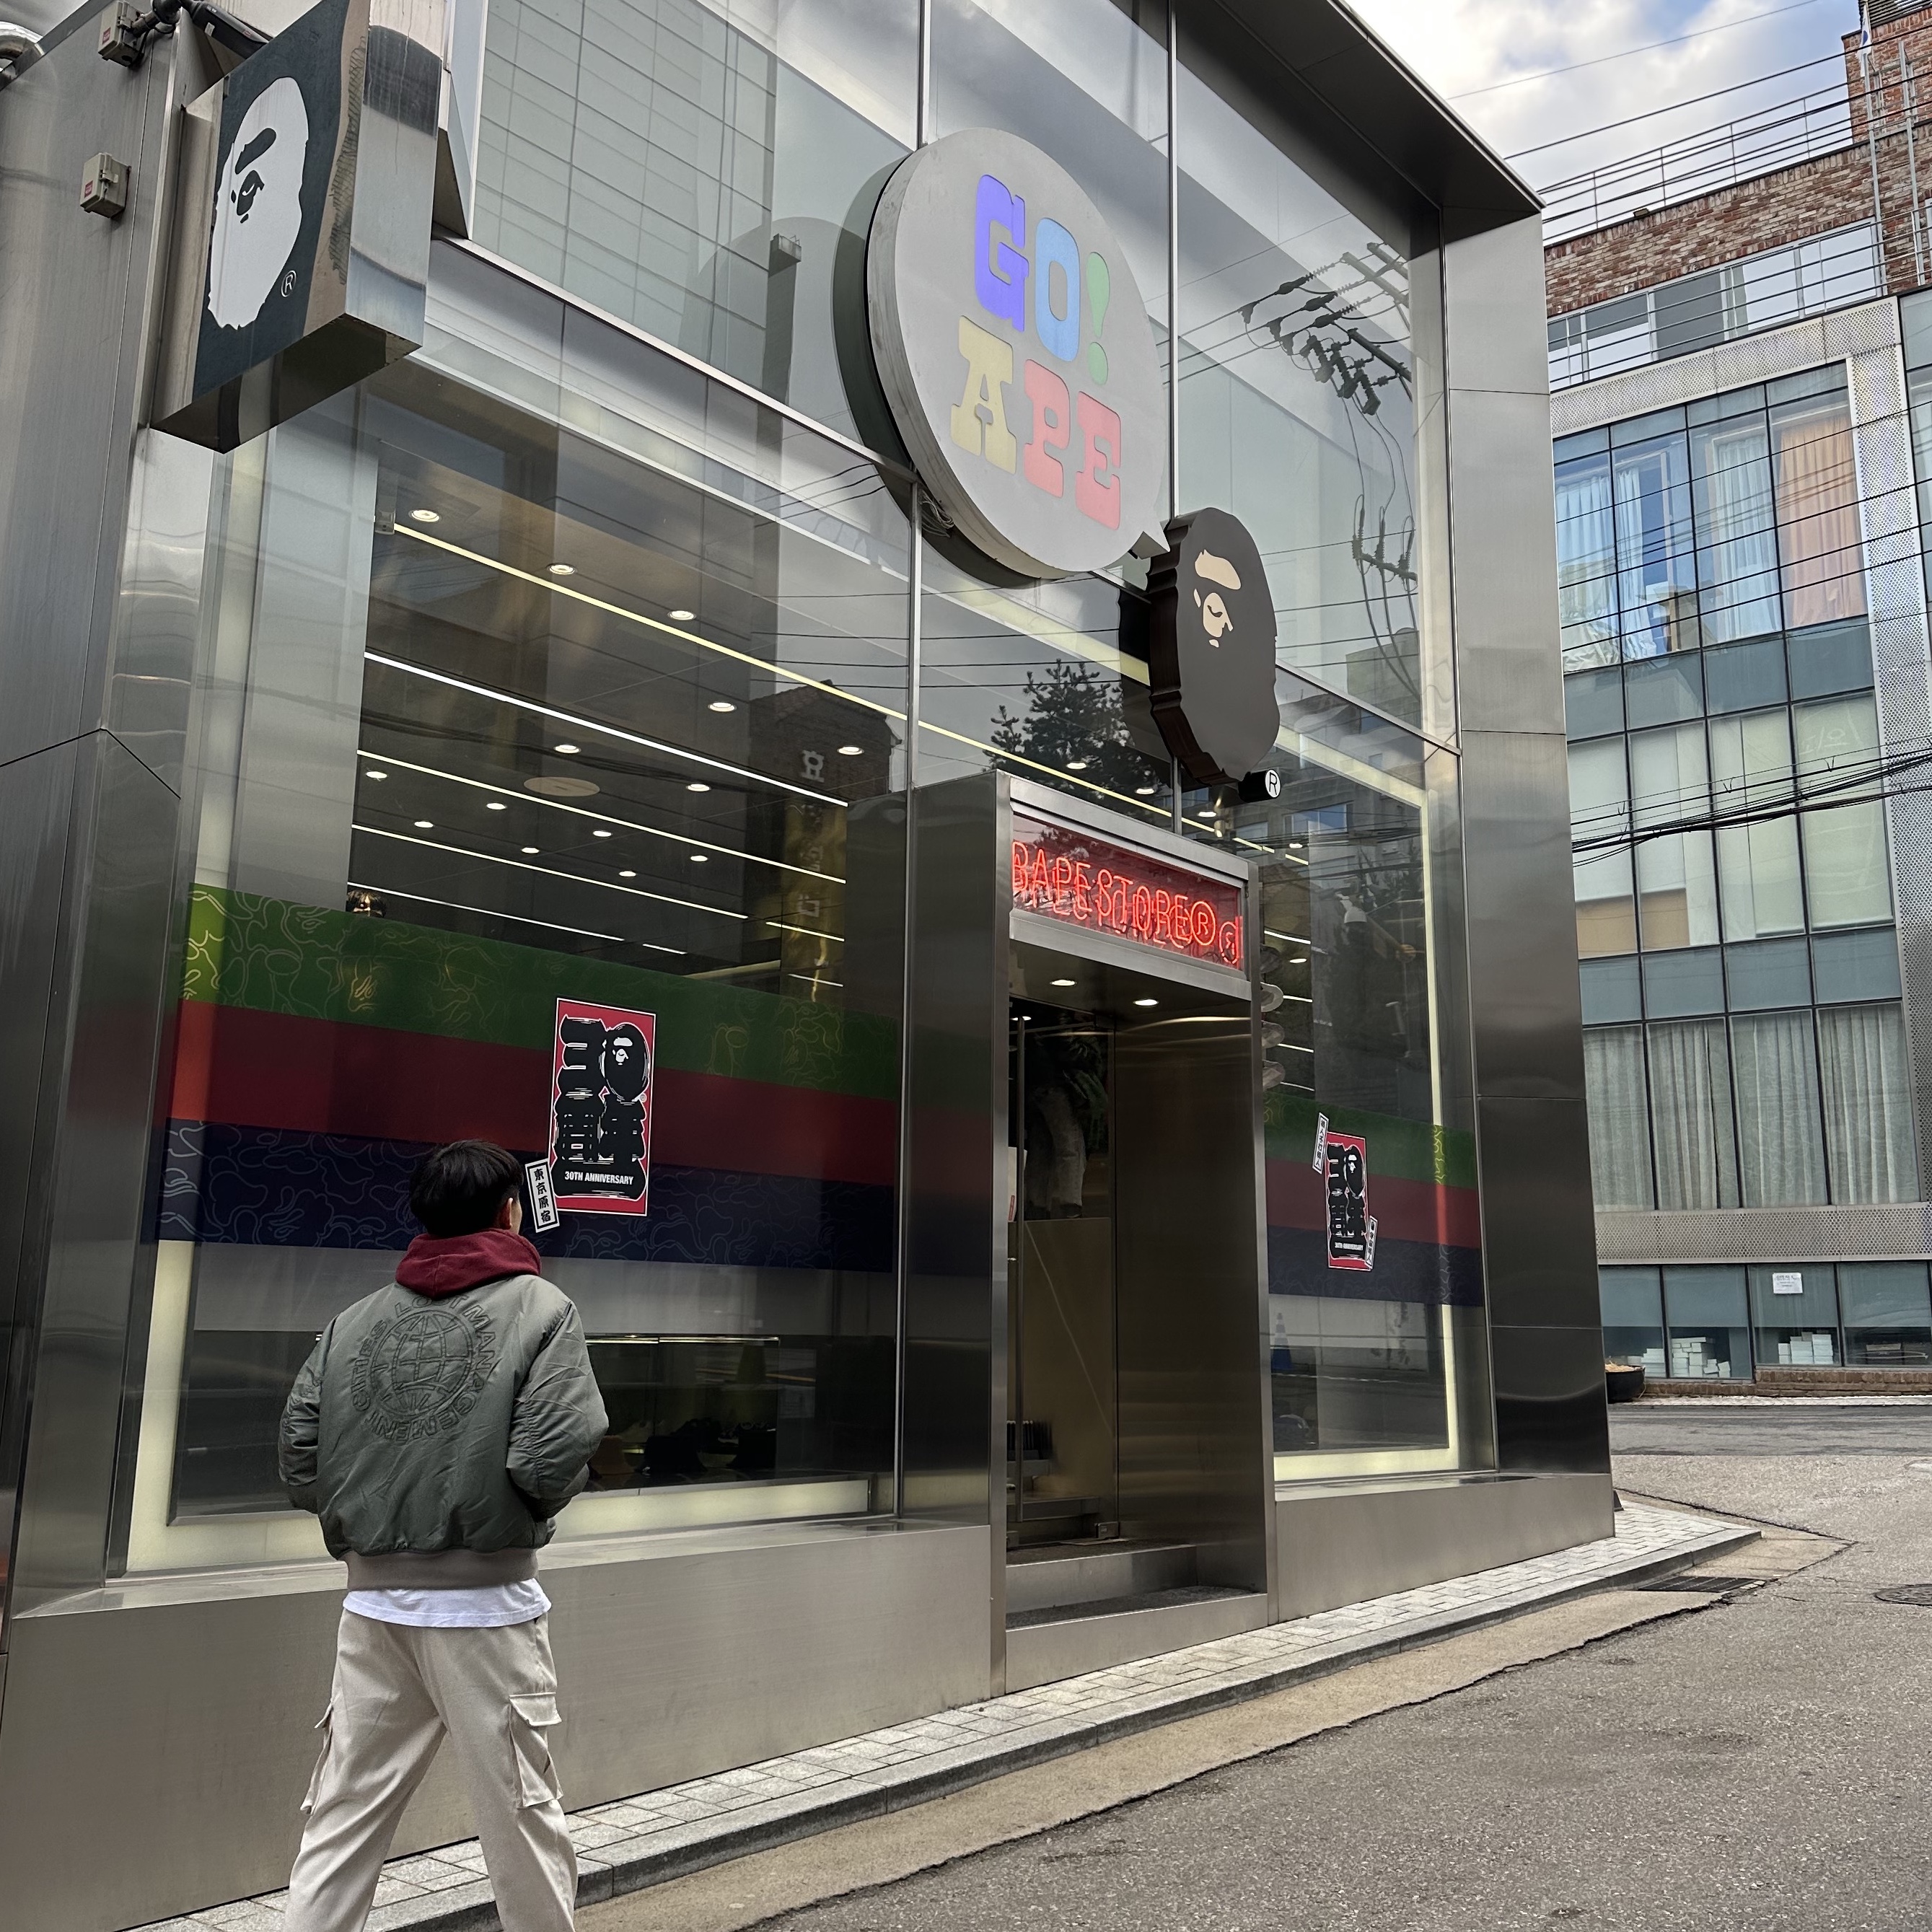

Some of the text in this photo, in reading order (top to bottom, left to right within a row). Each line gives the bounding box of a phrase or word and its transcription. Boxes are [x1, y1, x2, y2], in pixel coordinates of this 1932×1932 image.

[974, 174, 1111, 385] GO!
[950, 315, 1122, 530] APE
[1011, 841, 1093, 913] BAPE
[533, 1168, 551, 1224] 東京原宿
[564, 1171, 634, 1185] 30TH ANNIVERSARY
[351, 1319, 388, 1412] CITIES
